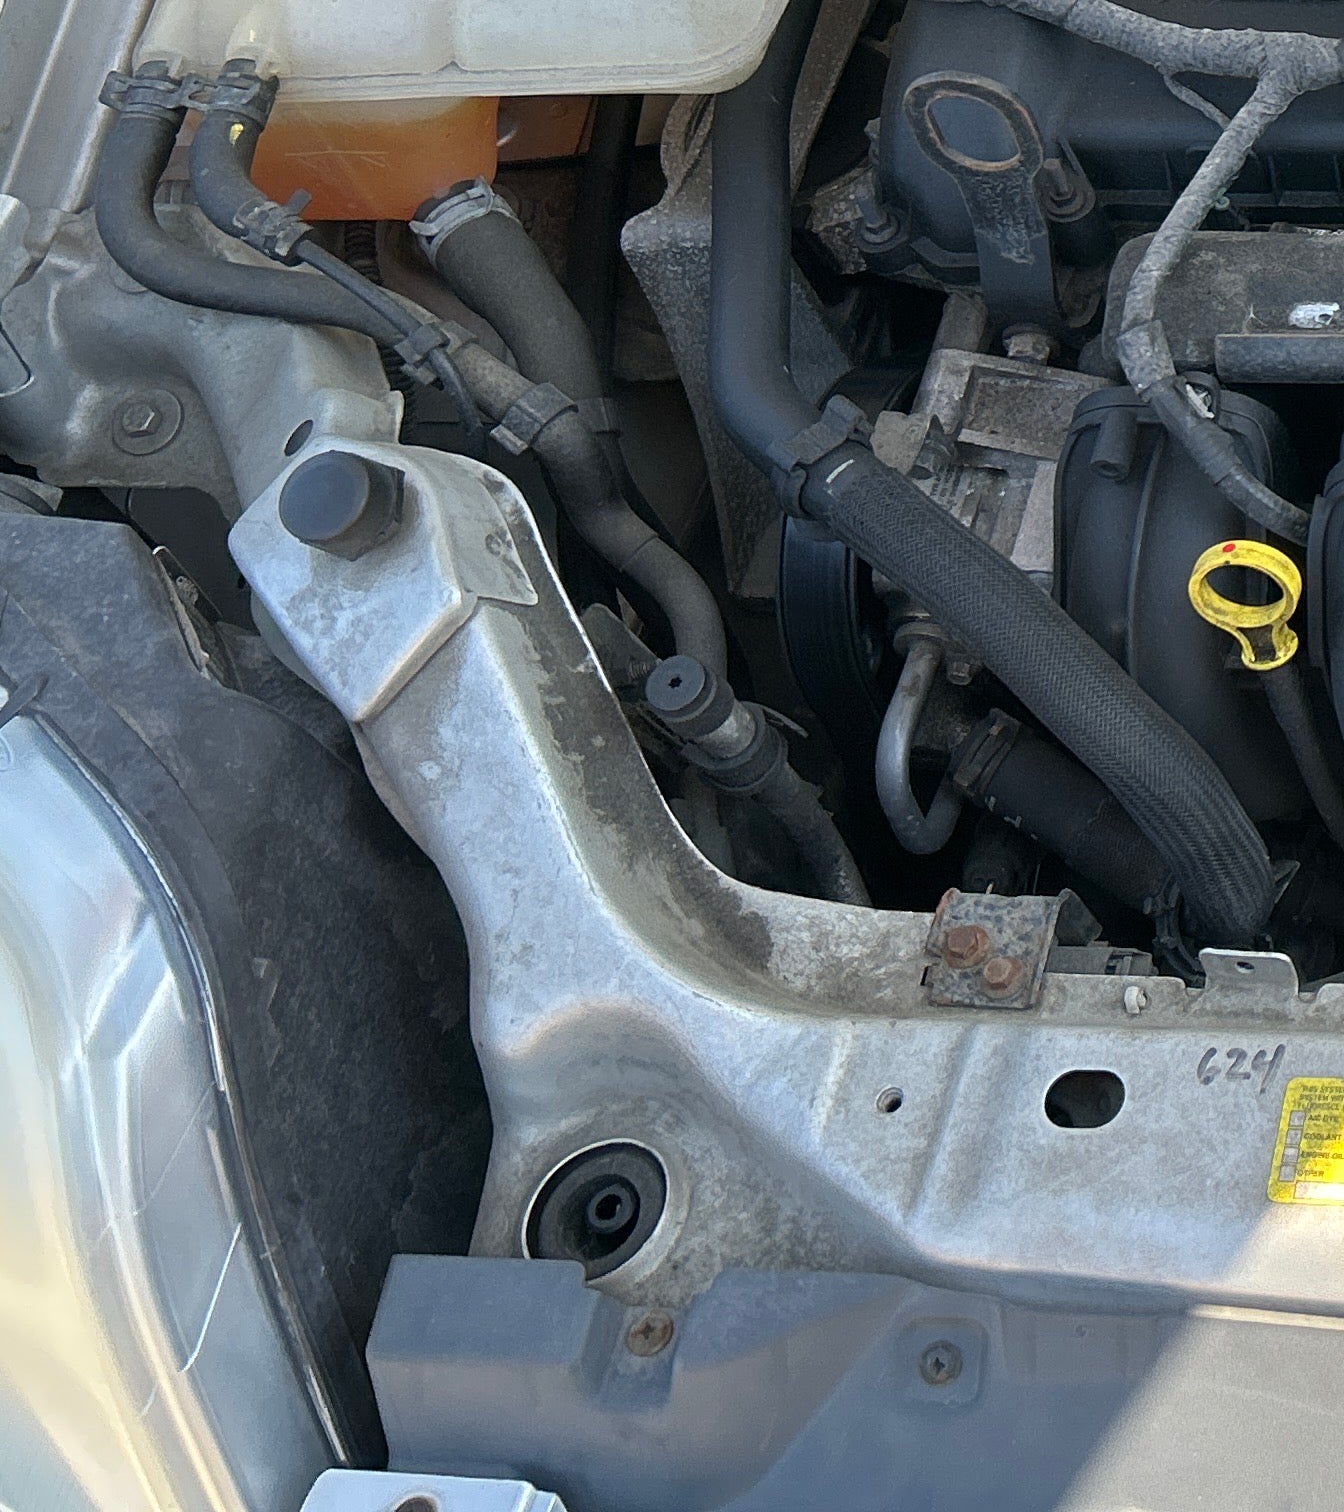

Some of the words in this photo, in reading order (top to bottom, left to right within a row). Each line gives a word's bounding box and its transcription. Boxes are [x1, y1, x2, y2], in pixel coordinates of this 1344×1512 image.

[1197, 1044, 1286, 1094] 624
[1299, 1094, 1328, 1102] SYSTEM
[1323, 1114, 1339, 1122] DYE
[1303, 1133, 1342, 1141] COOLANT
[1296, 1169, 1324, 1177] OTHER
